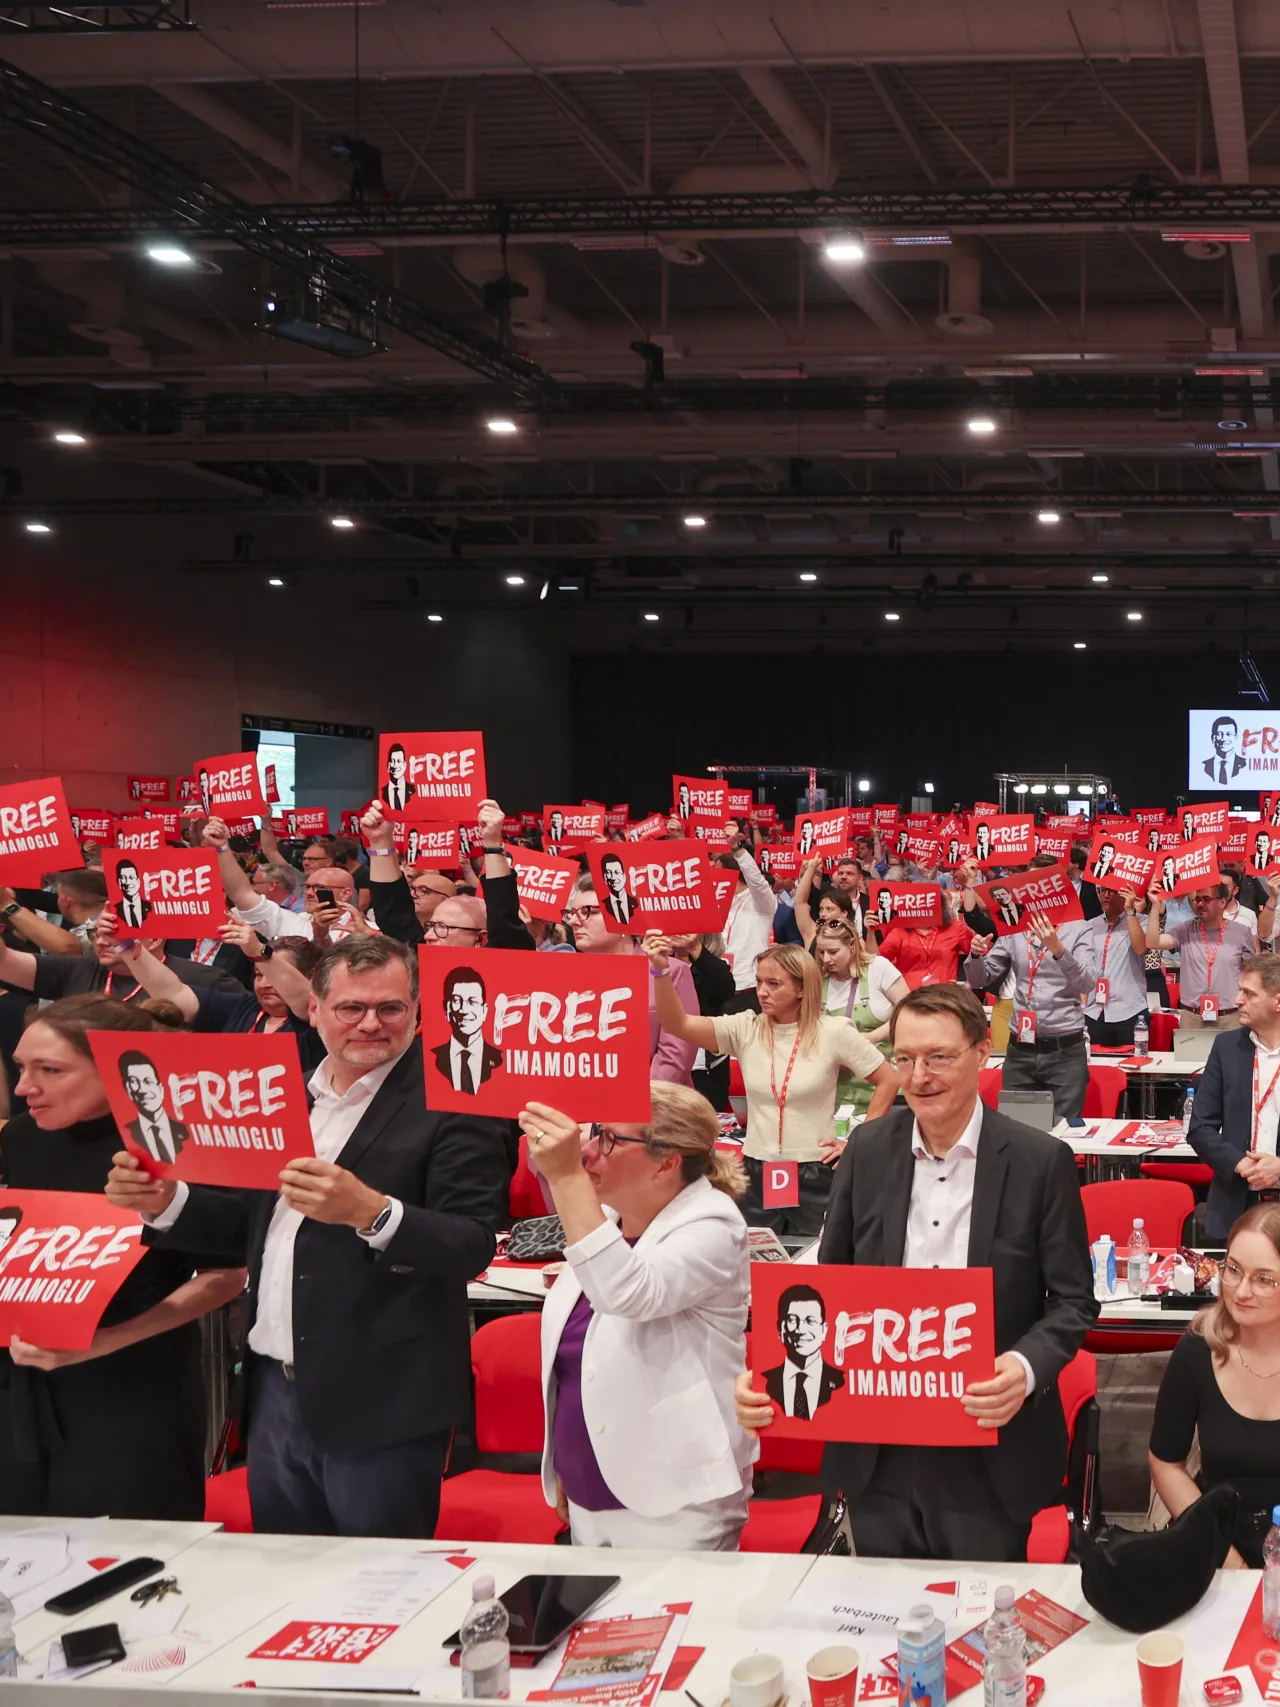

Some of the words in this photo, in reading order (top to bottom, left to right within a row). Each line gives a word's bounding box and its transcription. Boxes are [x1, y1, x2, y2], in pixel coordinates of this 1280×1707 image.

[408, 749, 476, 783] FREE
[210, 764, 252, 792] FREE
[213, 790, 252, 804] IMAMOGLU
[417, 783, 471, 798] IMAMOGLU
[689, 790, 724, 806] FREE
[2, 796, 57, 837] REE
[297, 812, 324, 824] FREE
[694, 807, 721, 817] IMAMOGLU
[879, 810, 896, 818] FREE
[1142, 812, 1165, 822] FREE
[1193, 810, 1225, 827] FREE
[80, 819, 109, 831] FREE
[231, 823, 253, 836] FREE
[300, 821, 323, 829] IMAMOGLU
[564, 815, 601, 828] FREE
[813, 816, 845, 839] FREE
[1196, 825, 1222, 833] IMAMOGLU
[418, 830, 456, 847] FREE
[705, 828, 725, 838] FRE
[816, 835, 841, 846] IMAMOGLU
[991, 823, 1030, 843] FREE
[1228, 834, 1248, 844] REE
[0, 832, 59, 854] MAMOGLU
[908, 838, 938, 850] FREE
[995, 843, 1027, 852] IMAMOGLU
[1039, 839, 1069, 850] FREE
[422, 849, 452, 857] IMAMOGLU
[908, 848, 932, 858] IMAMOGLU
[1176, 845, 1212, 872] FREE
[1113, 852, 1154, 874] FREE
[629, 858, 701, 896] FREE
[1114, 869, 1145, 885] IMAMOGLU
[1179, 865, 1210, 881] IMAMOGLU
[143, 865, 211, 900] FREE
[1012, 874, 1065, 903] FREE
[154, 901, 210, 915] IMAMOGLU
[639, 895, 701, 911] IMAMOGLU
[894, 892, 936, 909] FREE
[1025, 894, 1069, 912] IMAMOGLU
[899, 909, 933, 918] IMAMOGLU
[1098, 982, 1105, 994] D
[1204, 1000, 1214, 1012] D
[492, 988, 632, 1046] FREE
[1022, 1016, 1032, 1032] D
[505, 1050, 619, 1078] IMAMOGLU
[168, 1064, 286, 1122] FREE
[191, 1122, 285, 1152] IMAMOGLU
[771, 1169, 790, 1190] D
[0, 1225, 144, 1274] FREE
[833, 1302, 978, 1367] FREE
[849, 1368, 964, 1397] IMAMOGLU
[832, 1604, 900, 1626] Lauterbach
[837, 1623, 866, 1636] Karl
